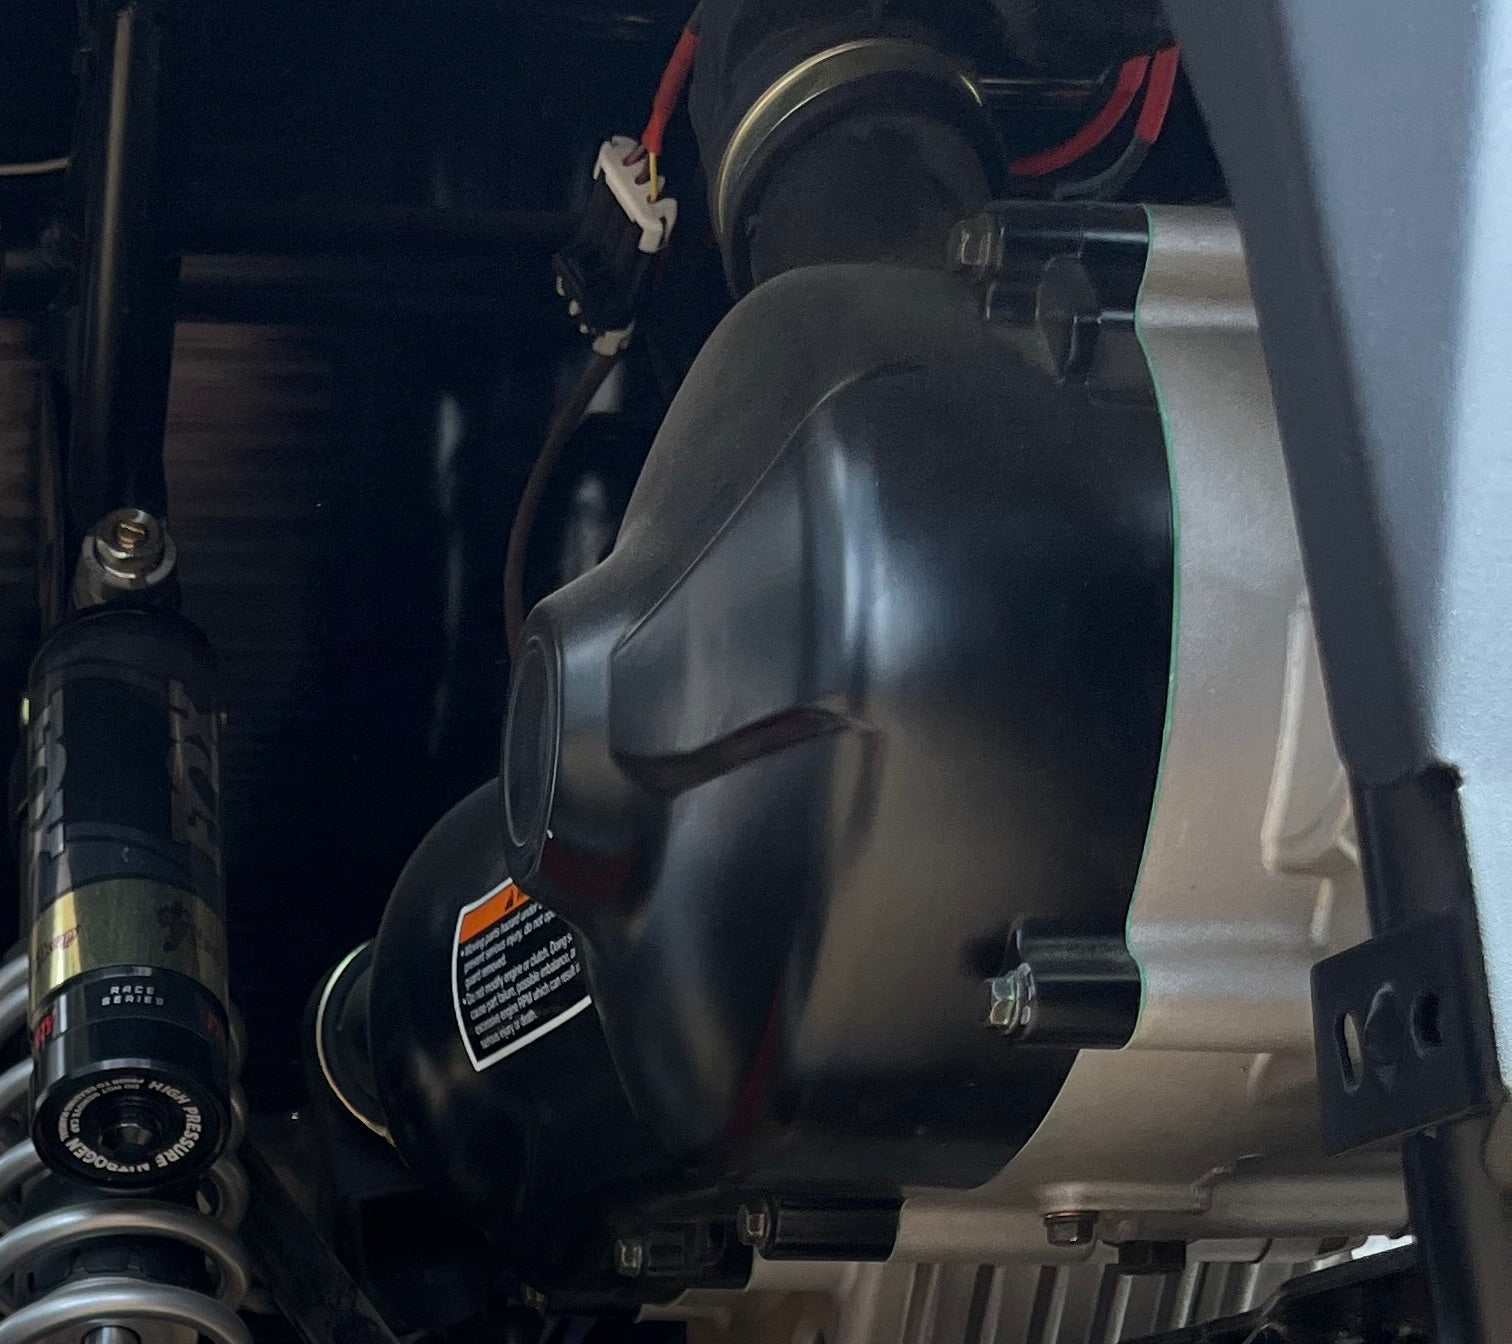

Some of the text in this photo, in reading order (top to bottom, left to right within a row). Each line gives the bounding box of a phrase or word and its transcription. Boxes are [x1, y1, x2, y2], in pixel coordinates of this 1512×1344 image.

[109, 985, 155, 995] RACE
[101, 994, 165, 1007] SERIES
[147, 1080, 192, 1105] HIGH
[154, 1105, 202, 1168] PRESSURE
